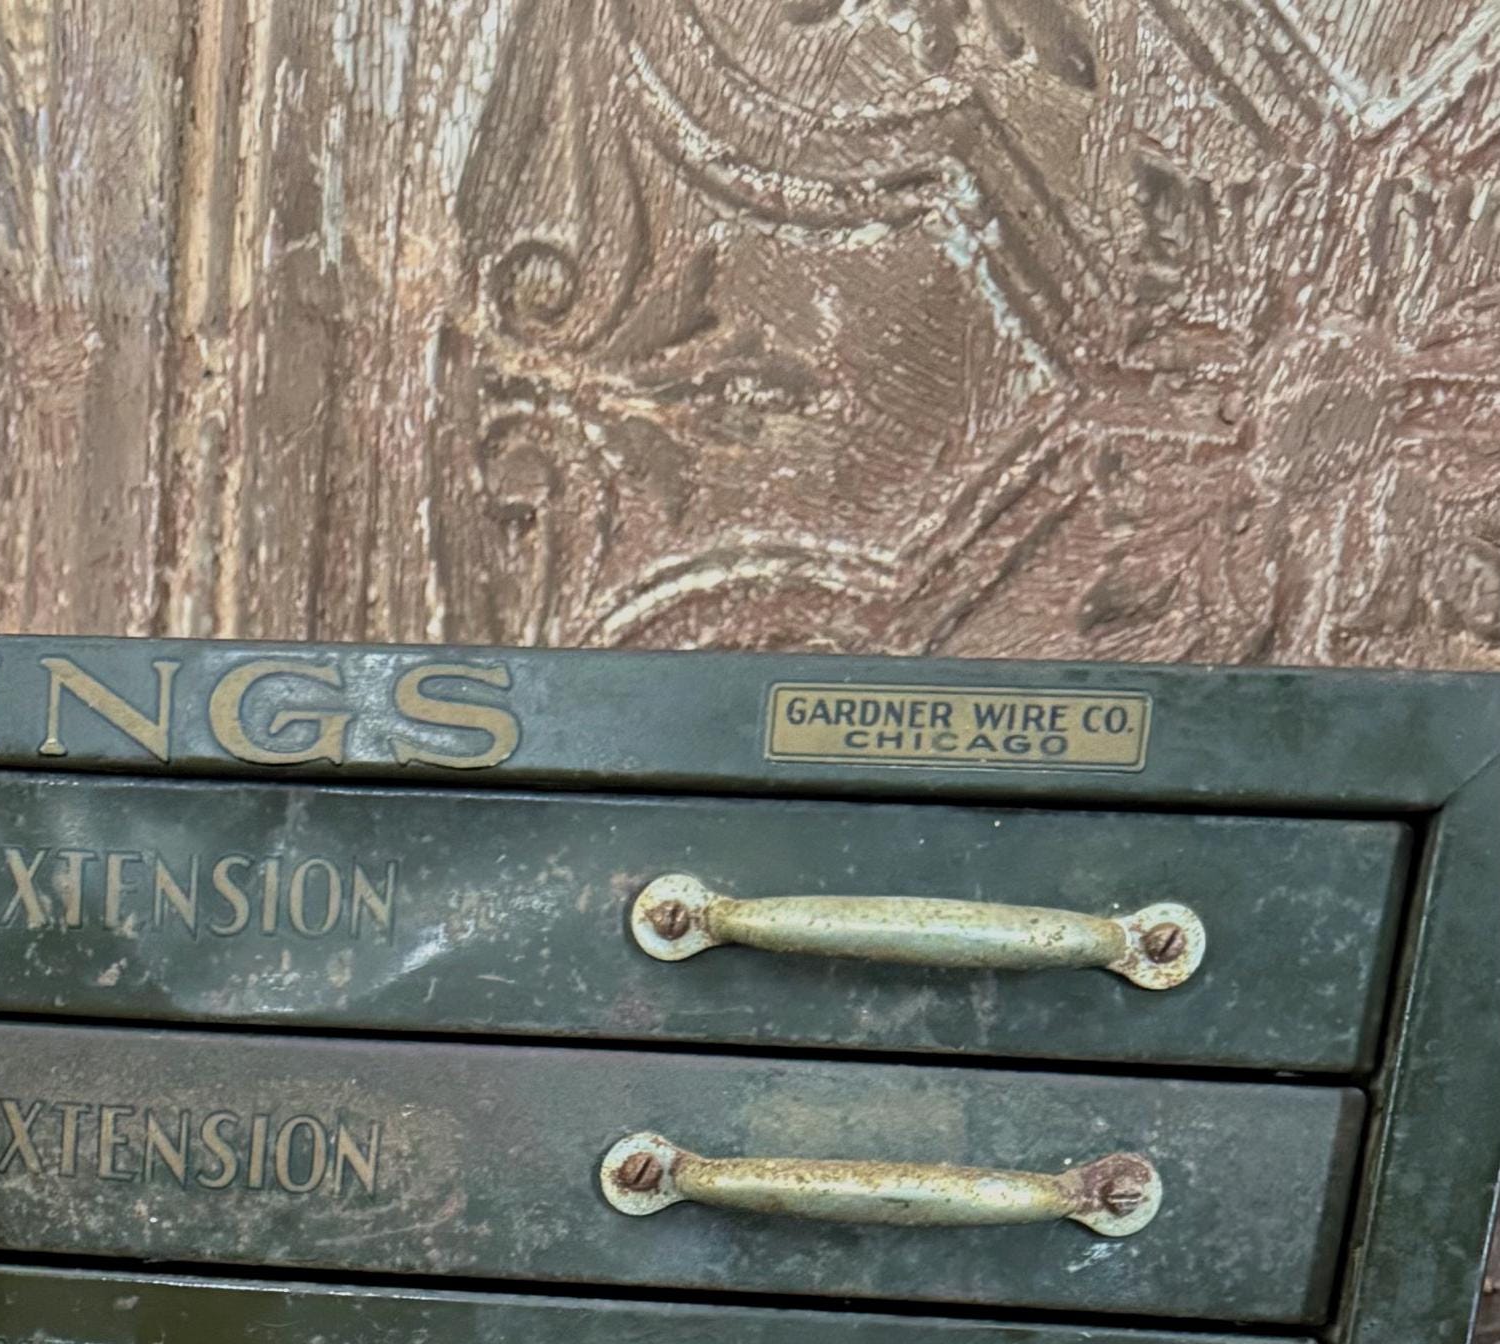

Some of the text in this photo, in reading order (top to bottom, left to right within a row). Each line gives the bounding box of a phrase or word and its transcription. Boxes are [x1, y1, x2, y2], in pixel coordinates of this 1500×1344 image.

[786, 697, 1135, 736] GARDNER WIRE CO.
[844, 729, 1070, 758] CHICAGO
